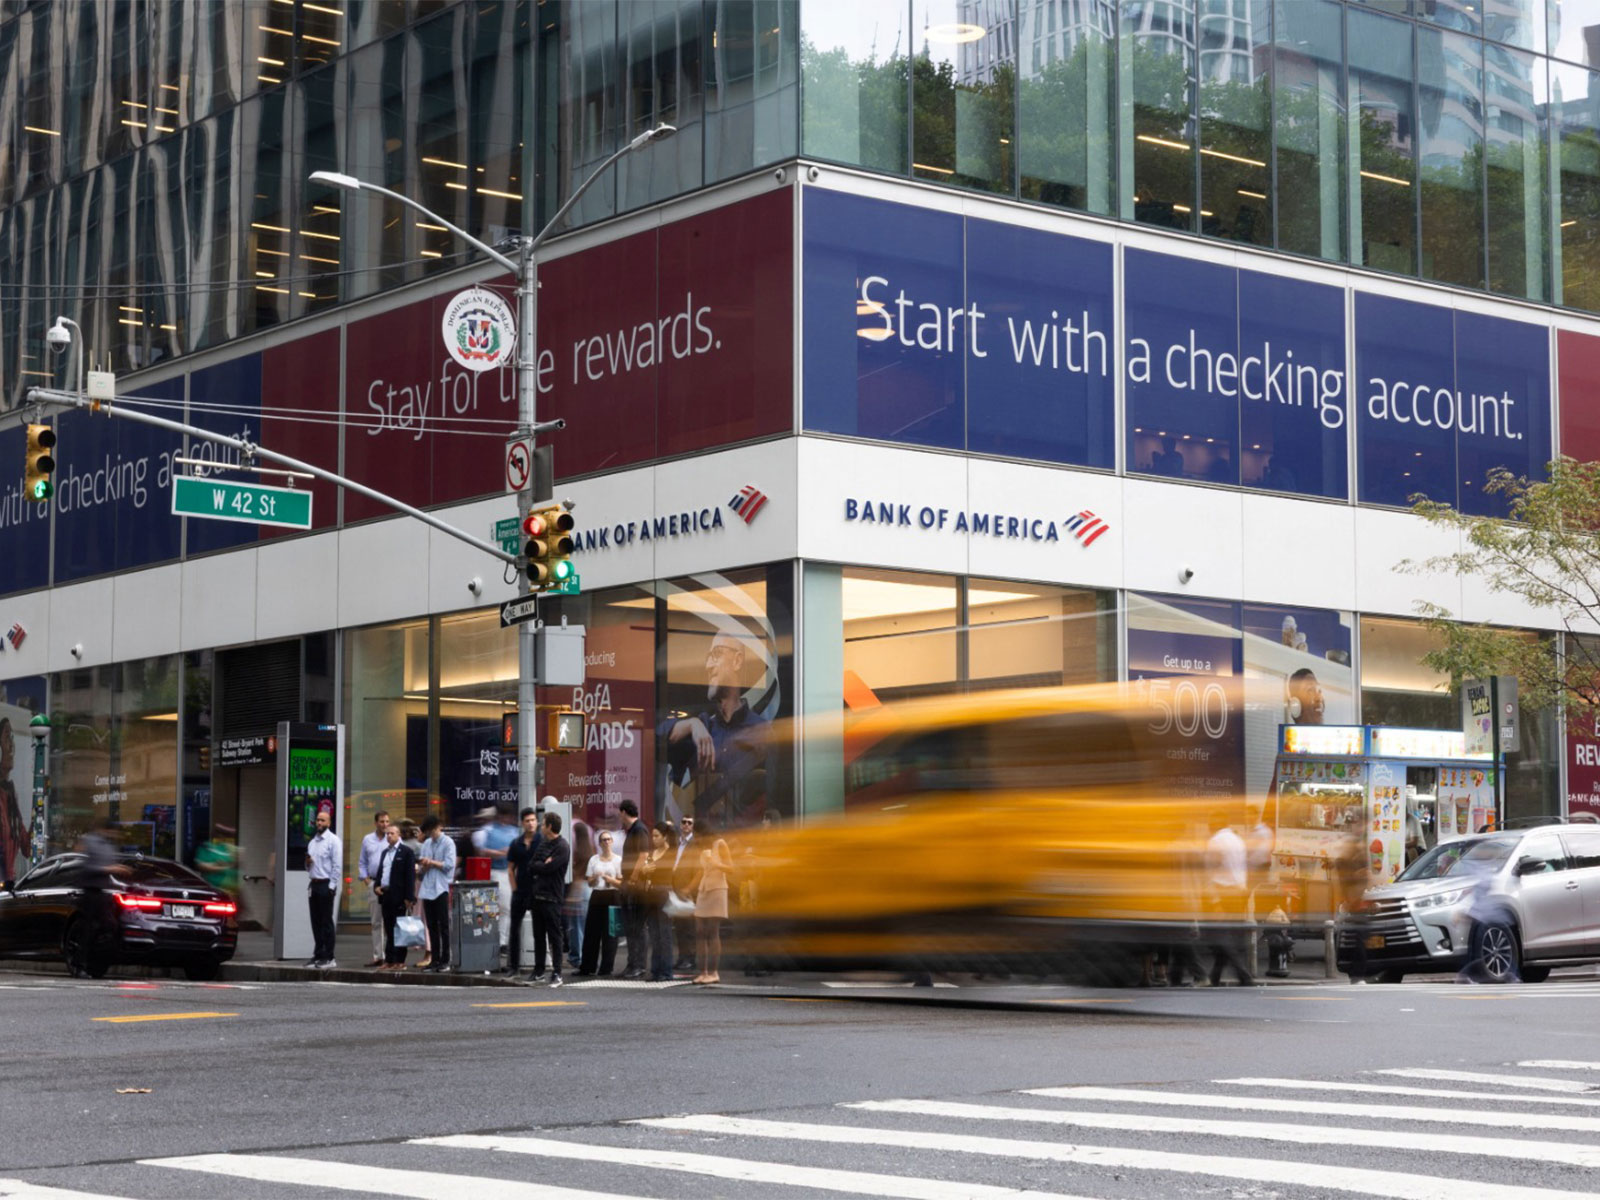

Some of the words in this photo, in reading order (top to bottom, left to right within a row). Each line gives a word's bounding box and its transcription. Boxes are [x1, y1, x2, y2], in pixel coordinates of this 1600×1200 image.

[447, 297, 482, 327] DOMINICAN
[484, 298, 511, 333] REPUBLIC
[367, 379, 431, 441] Stay
[440, 358, 482, 417] for
[573, 292, 721, 385] rewards.
[862, 276, 987, 357] Start
[1008, 310, 1107, 377] with
[1128, 338, 1150, 383] a
[1166, 329, 1344, 428] checking
[1368, 377, 1523, 440] account.
[58, 454, 148, 508] checking
[213, 489, 225, 510] W
[231, 492, 253, 514] 42
[259, 495, 276, 516] St
[570, 527, 608, 551] ANK
[614, 522, 635, 545] OF
[640, 507, 724, 541] AMERICA
[846, 498, 911, 526] BANK
[920, 507, 949, 529] OF
[956, 511, 1059, 541] AMERICA
[505, 607, 516, 619] ONE
[521, 603, 533, 613] WAY
[584, 651, 616, 667] oducing
[1163, 655, 1179, 668] Get
[1181, 658, 1192, 671] up
[1194, 658, 1203, 669] to
[1205, 661, 1211, 670] a
[572, 684, 611, 720] BofA
[584, 720, 634, 751] ARDS
[1167, 748, 1187, 760] cash
[1189, 748, 1210, 760] offer
[568, 770, 602, 787] Rewards
[604, 769, 616, 785] for
[455, 787, 473, 800] Talk
[476, 788, 486, 800] to
[488, 791, 499, 800] an
[501, 788, 519, 801] adv
[563, 790, 584, 808] every
[586, 788, 622, 804] ambition
